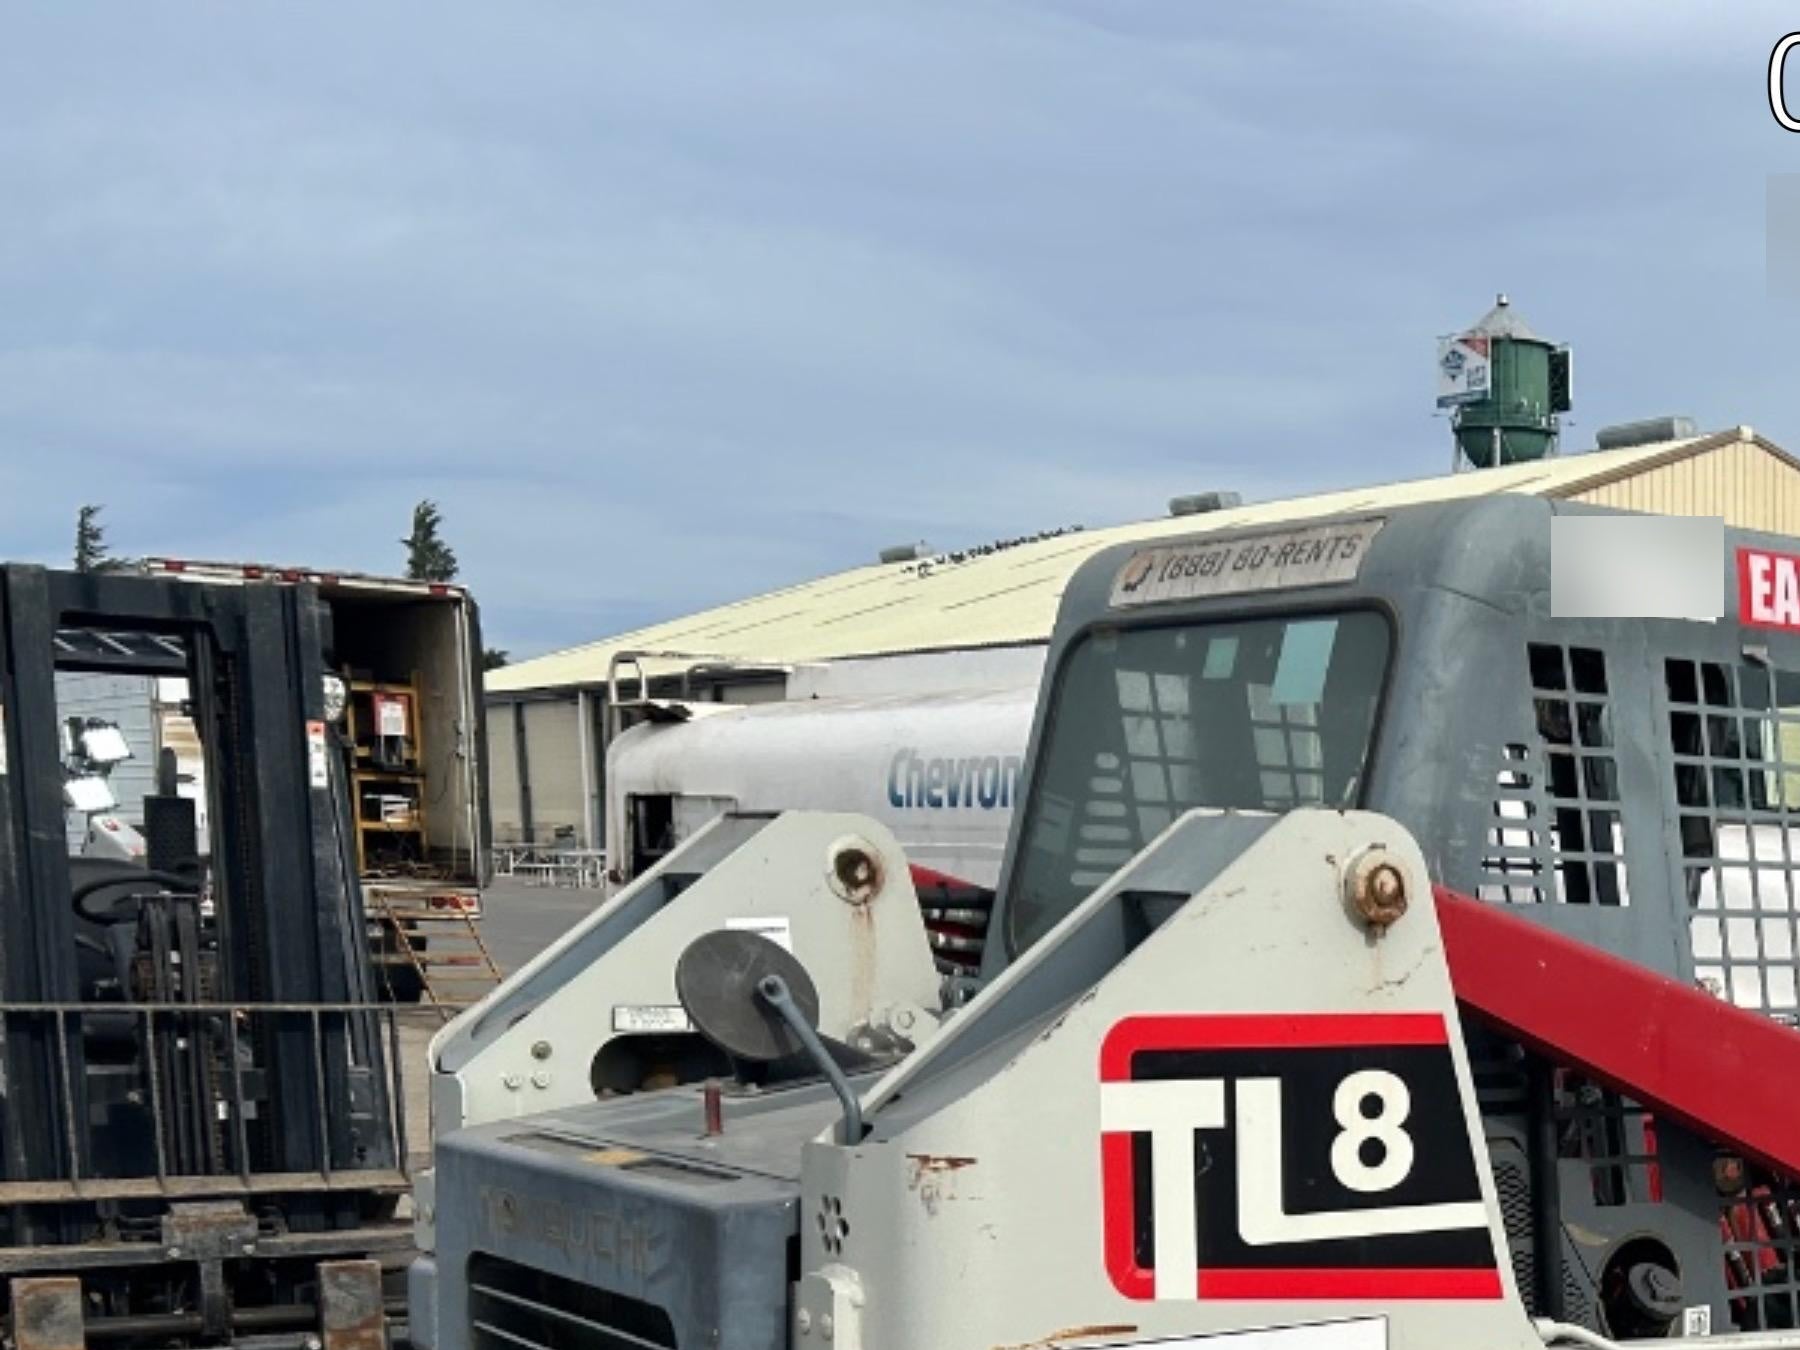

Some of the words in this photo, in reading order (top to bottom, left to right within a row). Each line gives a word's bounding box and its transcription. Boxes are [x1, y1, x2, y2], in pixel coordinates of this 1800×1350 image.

[1158, 549, 1226, 582] (888)
[1233, 534, 1362, 571] 80-RENTS
[888, 747, 1024, 810] Chevron
